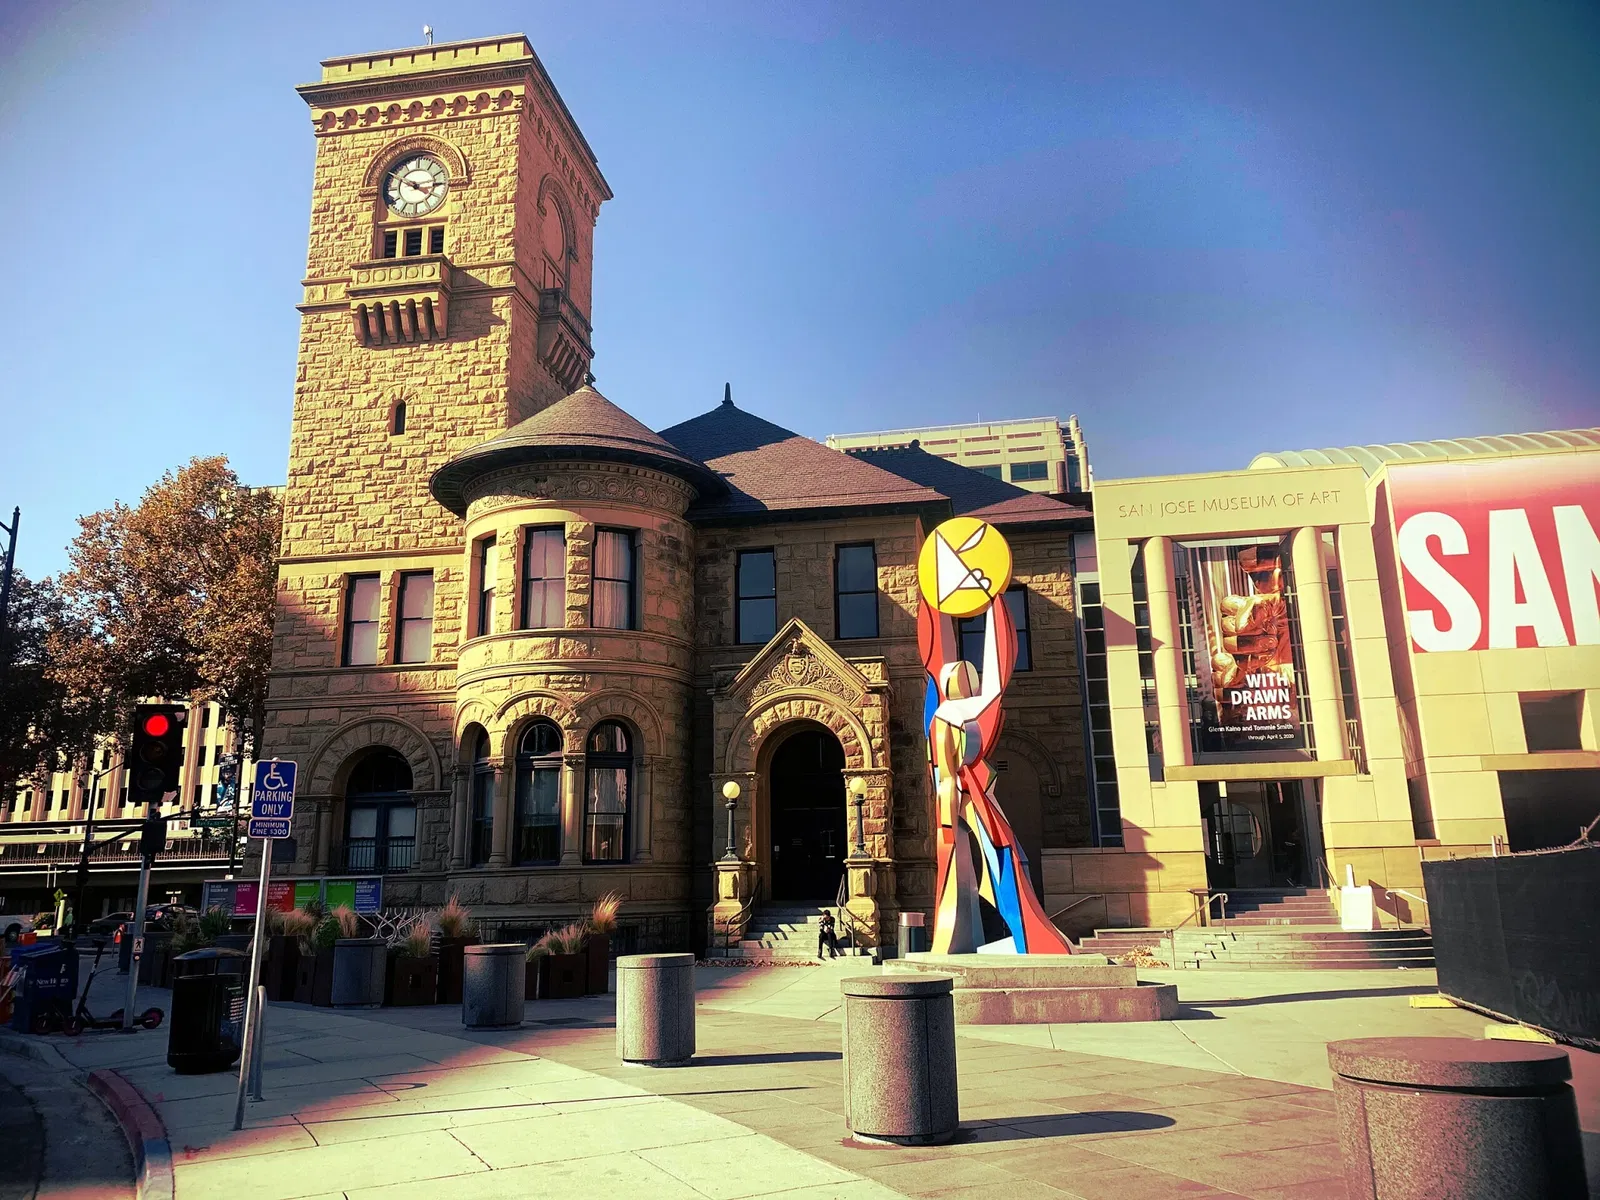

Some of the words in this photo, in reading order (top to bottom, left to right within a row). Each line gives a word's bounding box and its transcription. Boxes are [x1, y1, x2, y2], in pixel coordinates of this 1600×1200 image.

[1118, 504, 1153, 518] SAN
[1160, 500, 1197, 518] JOSE
[1203, 495, 1277, 513] MUSEUM
[1282, 492, 1304, 507] OF
[1309, 490, 1341, 505] ART
[1245, 673, 1288, 688] WITH
[1230, 689, 1290, 705] DRAWN
[1246, 704, 1292, 721] ARMS
[1208, 725, 1225, 733] Glenn
[1225, 724, 1241, 732] Kaino
[1254, 723, 1276, 731] Tommie
[1266, 733, 1278, 741] April
[254, 790, 293, 803] PARKING
[261, 803, 284, 815] ONLY
